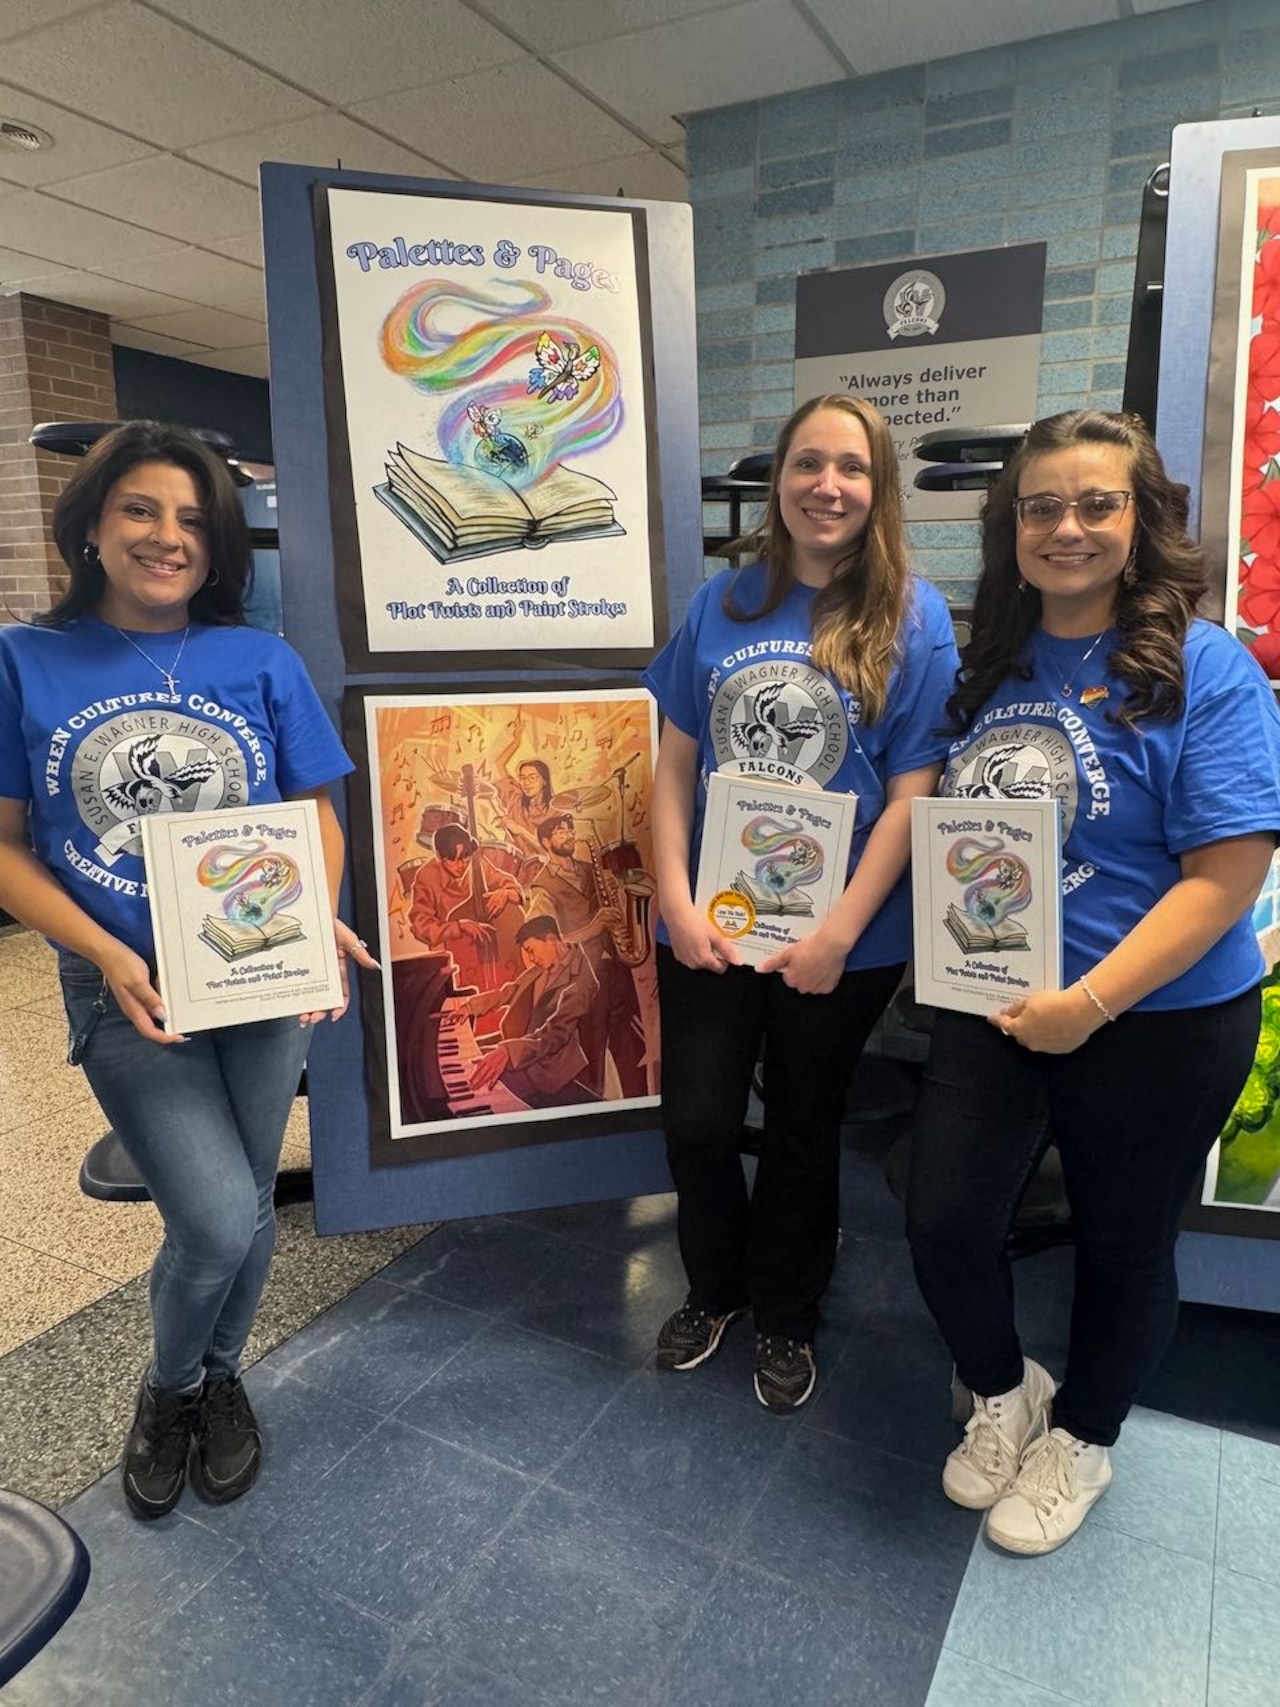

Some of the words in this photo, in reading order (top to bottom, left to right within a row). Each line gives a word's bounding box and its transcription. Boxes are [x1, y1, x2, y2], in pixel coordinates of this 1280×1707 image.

[347, 236, 485, 273] Palettes
[493, 240, 521, 268] &
[528, 244, 620, 293] Pages
[864, 393, 909, 407] more
[916, 389, 959, 403] than
[919, 366, 987, 383] deliver
[884, 406, 961, 426] pected."
[386, 602, 425, 619] Plot
[428, 602, 482, 619] Twists
[485, 600, 516, 618] and
[519, 601, 565, 618] Paint
[568, 598, 627, 619] Strokes
[446, 577, 464, 596] A
[467, 577, 549, 597] Collection
[551, 576, 570, 597] of
[45, 727, 72, 797] WHEN
[68, 691, 182, 730] CULTURES
[188, 694, 267, 786] CONVERGE,
[716, 705, 729, 754] SUSAN
[734, 665, 798, 688] WAGNER
[802, 673, 832, 707] HIGH
[819, 713, 841, 770] SCHOOL
[79, 769, 109, 825] SUSAN
[95, 716, 169, 748] WAGNER
[180, 722, 221, 745] HIGH
[738, 762, 804, 785] FALCONS
[976, 729, 1042, 753] WAGNER
[1042, 735, 1068, 766] HIGH
[1055, 771, 1069, 820] SCH
[1057, 707, 1111, 821] CONVERGE,
[64, 839, 137, 897] CREATIVE
